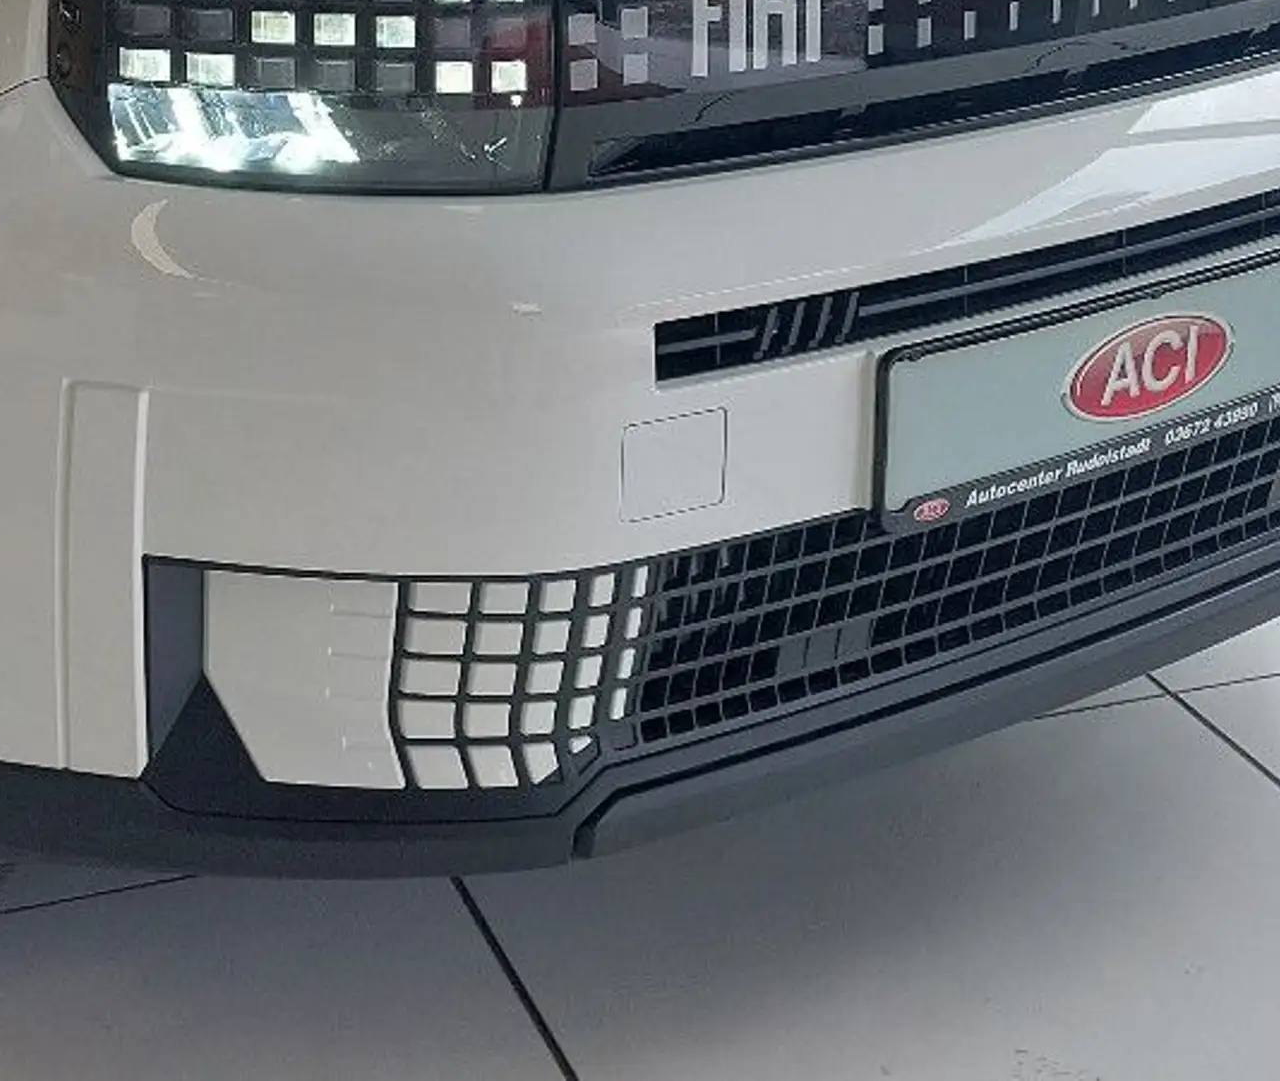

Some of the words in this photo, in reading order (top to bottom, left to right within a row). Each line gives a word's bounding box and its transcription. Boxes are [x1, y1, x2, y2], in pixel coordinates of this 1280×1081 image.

[1100, 325, 1199, 407] ACI
[963, 468, 1064, 509] Autocenter
[1065, 437, 1152, 478] Rudolstadt
